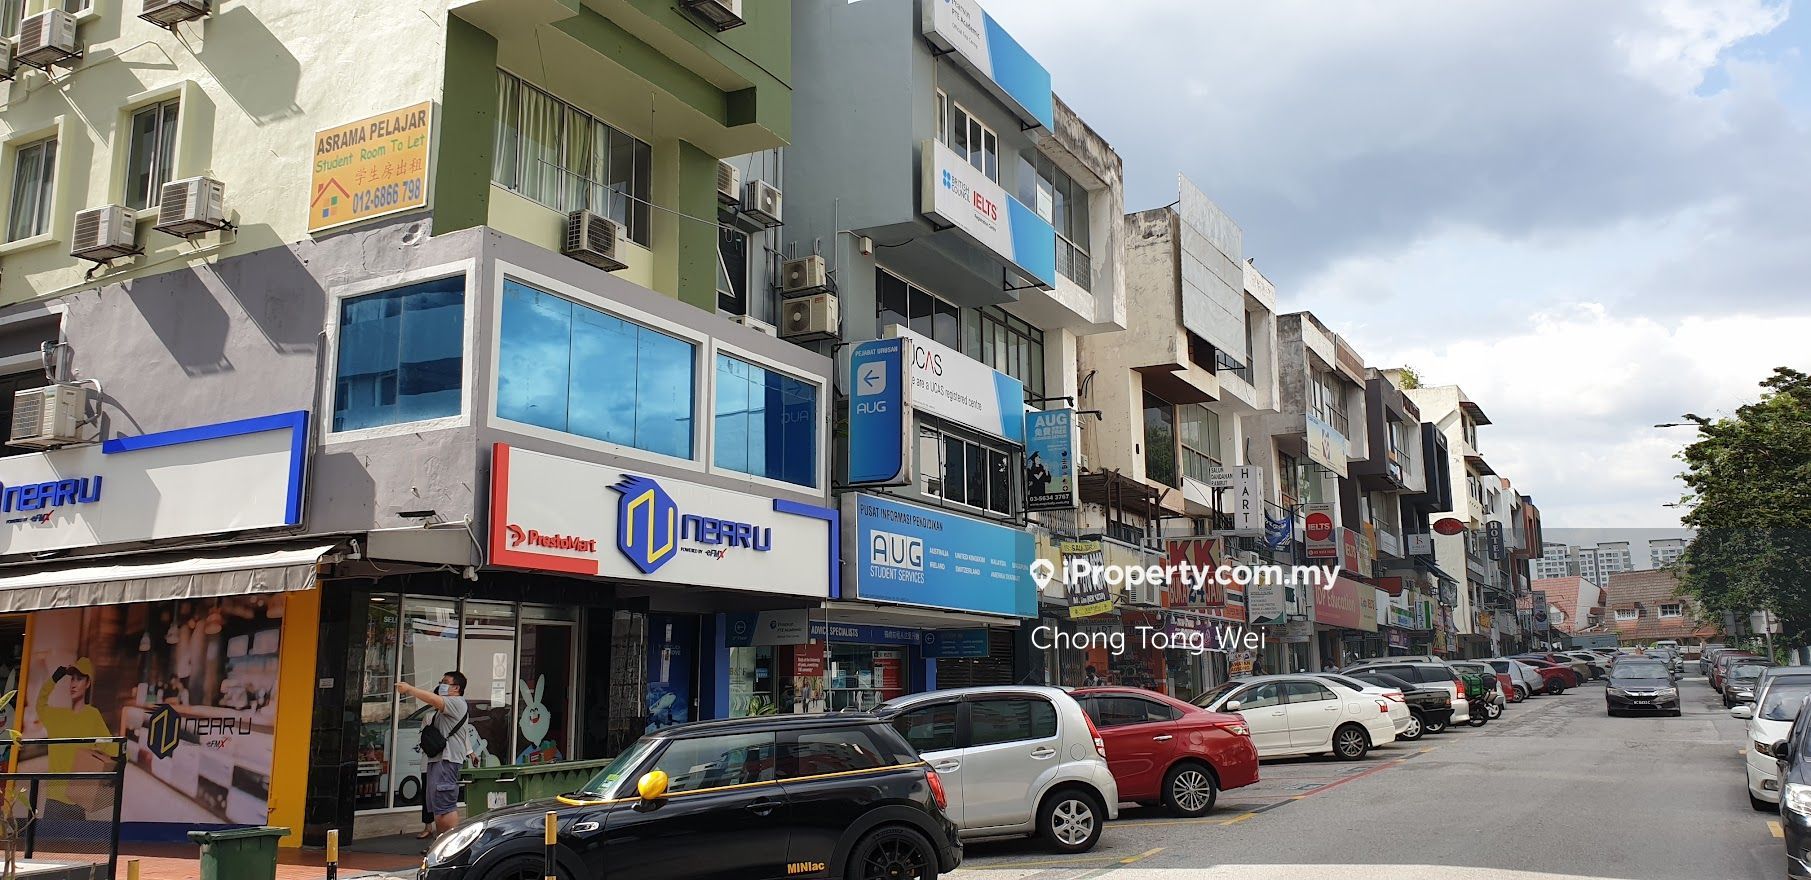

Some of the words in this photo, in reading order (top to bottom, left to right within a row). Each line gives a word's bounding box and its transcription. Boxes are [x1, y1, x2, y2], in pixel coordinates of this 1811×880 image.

[316, 126, 366, 156] ASRAMA
[369, 110, 426, 140] PELAJAR
[316, 152, 354, 174] Student
[360, 145, 386, 161] Room
[390, 138, 403, 152] To
[408, 134, 425, 150] Let
[355, 157, 422, 186] 学生房出租
[952, 176, 970, 192] BRITISH
[952, 184, 970, 203] COUNCIL
[352, 182, 398, 214] 012-6866
[402, 178, 421, 202] 798
[974, 190, 997, 221] IELTS
[916, 378, 925, 388] are
[926, 382, 929, 390] a
[931, 382, 944, 396] UCAS
[856, 400, 886, 415] AUG
[1034, 413, 1067, 428] AUG
[860, 504, 879, 518] PUSAT
[881, 508, 911, 525] INFORMASI
[913, 516, 943, 531] PENDIDIKAN
[1308, 522, 1330, 531] IELTS
[528, 530, 596, 552] PrestoMart
[874, 535, 921, 567] AUG
[1490, 522, 1500, 559] HOTEL
[1170, 540, 1217, 572] KK
[870, 565, 897, 580] STUDENT
[898, 569, 924, 584] SERVICES
[830, 626, 859, 637] SPECIALISTS
[788, 862, 825, 874] MINIac
